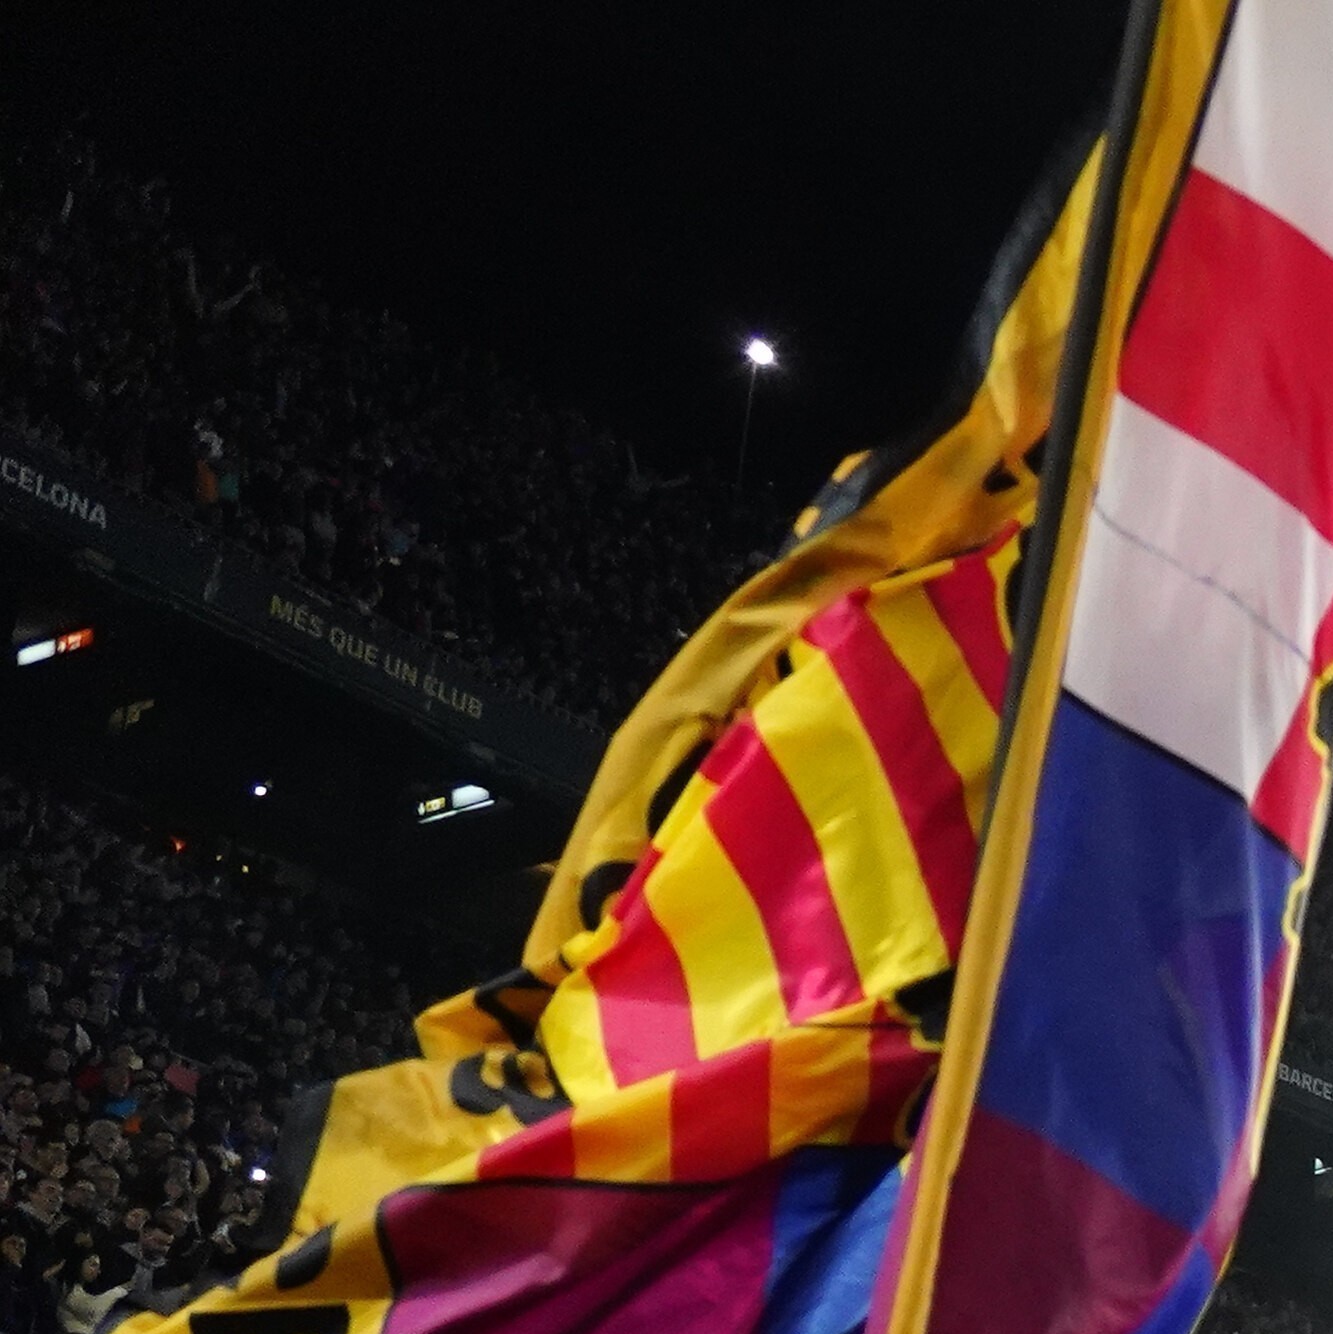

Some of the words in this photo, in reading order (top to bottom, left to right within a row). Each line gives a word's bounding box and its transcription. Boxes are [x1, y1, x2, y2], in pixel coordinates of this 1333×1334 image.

[328, 627, 378, 666] QUE
[382, 653, 417, 687] UN
[423, 673, 483, 719] CLUB
